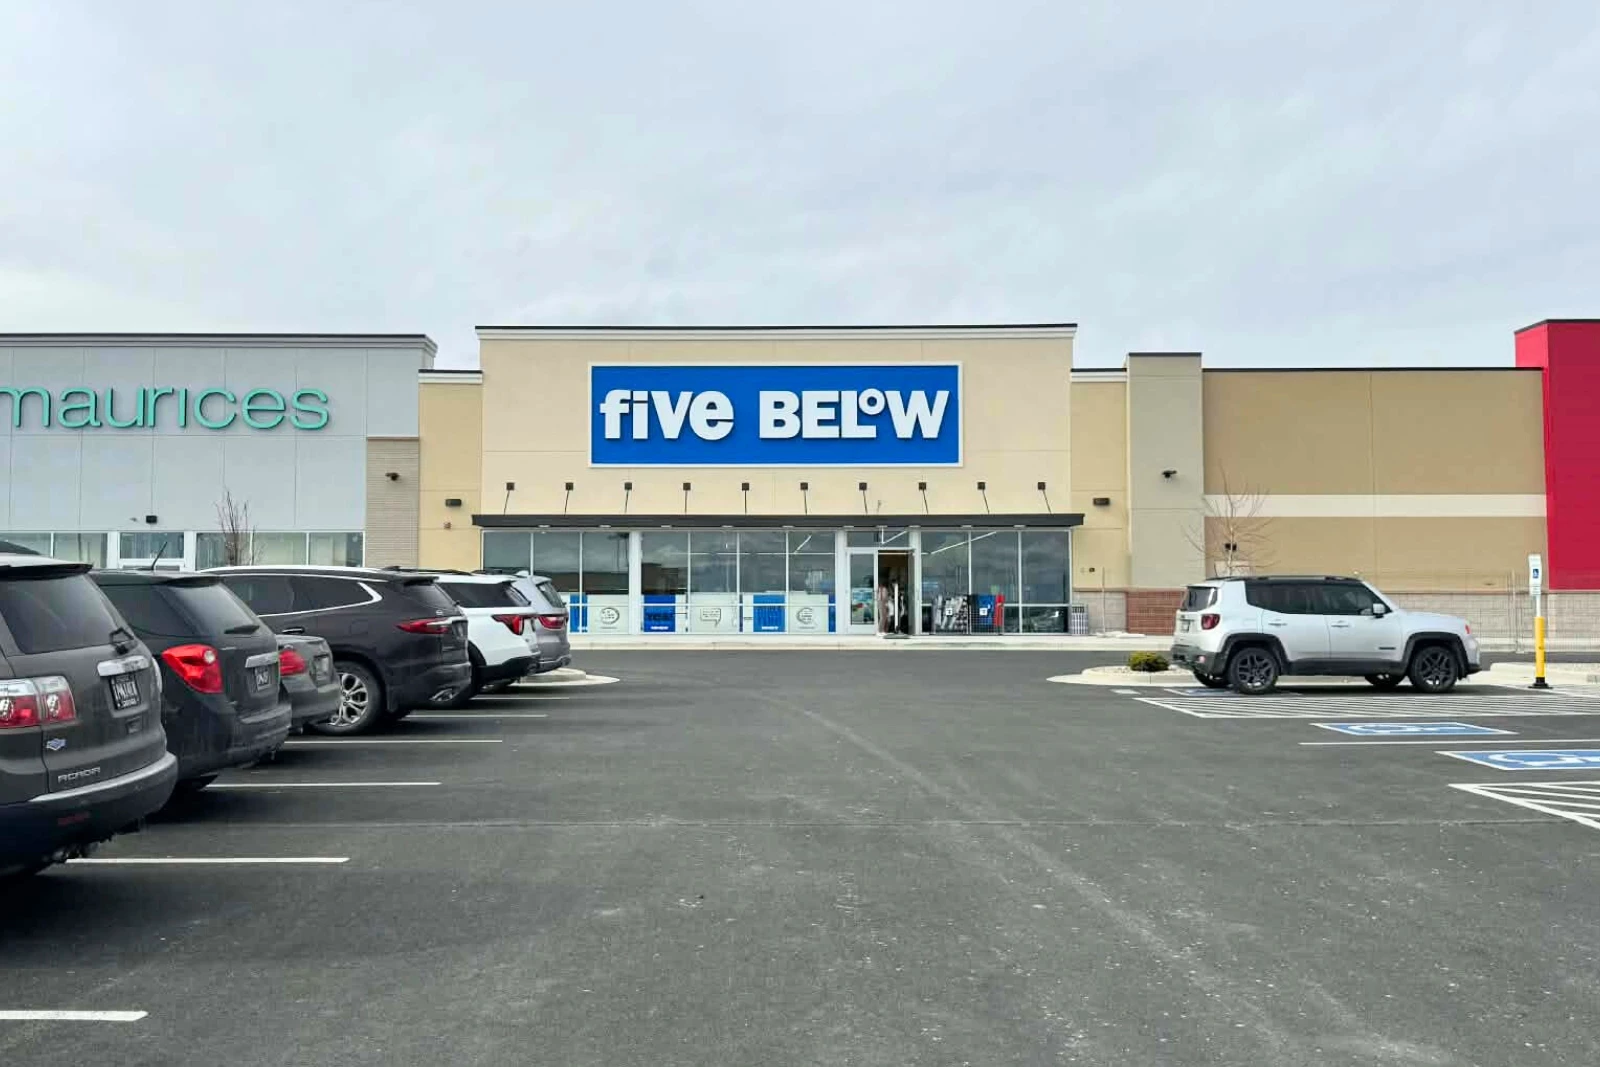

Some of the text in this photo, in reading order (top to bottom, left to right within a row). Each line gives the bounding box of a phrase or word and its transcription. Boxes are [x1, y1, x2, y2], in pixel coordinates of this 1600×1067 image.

[0, 387, 330, 430] maurices
[599, 388, 950, 440] five BELOW
[57, 767, 101, 783] ACADIA
